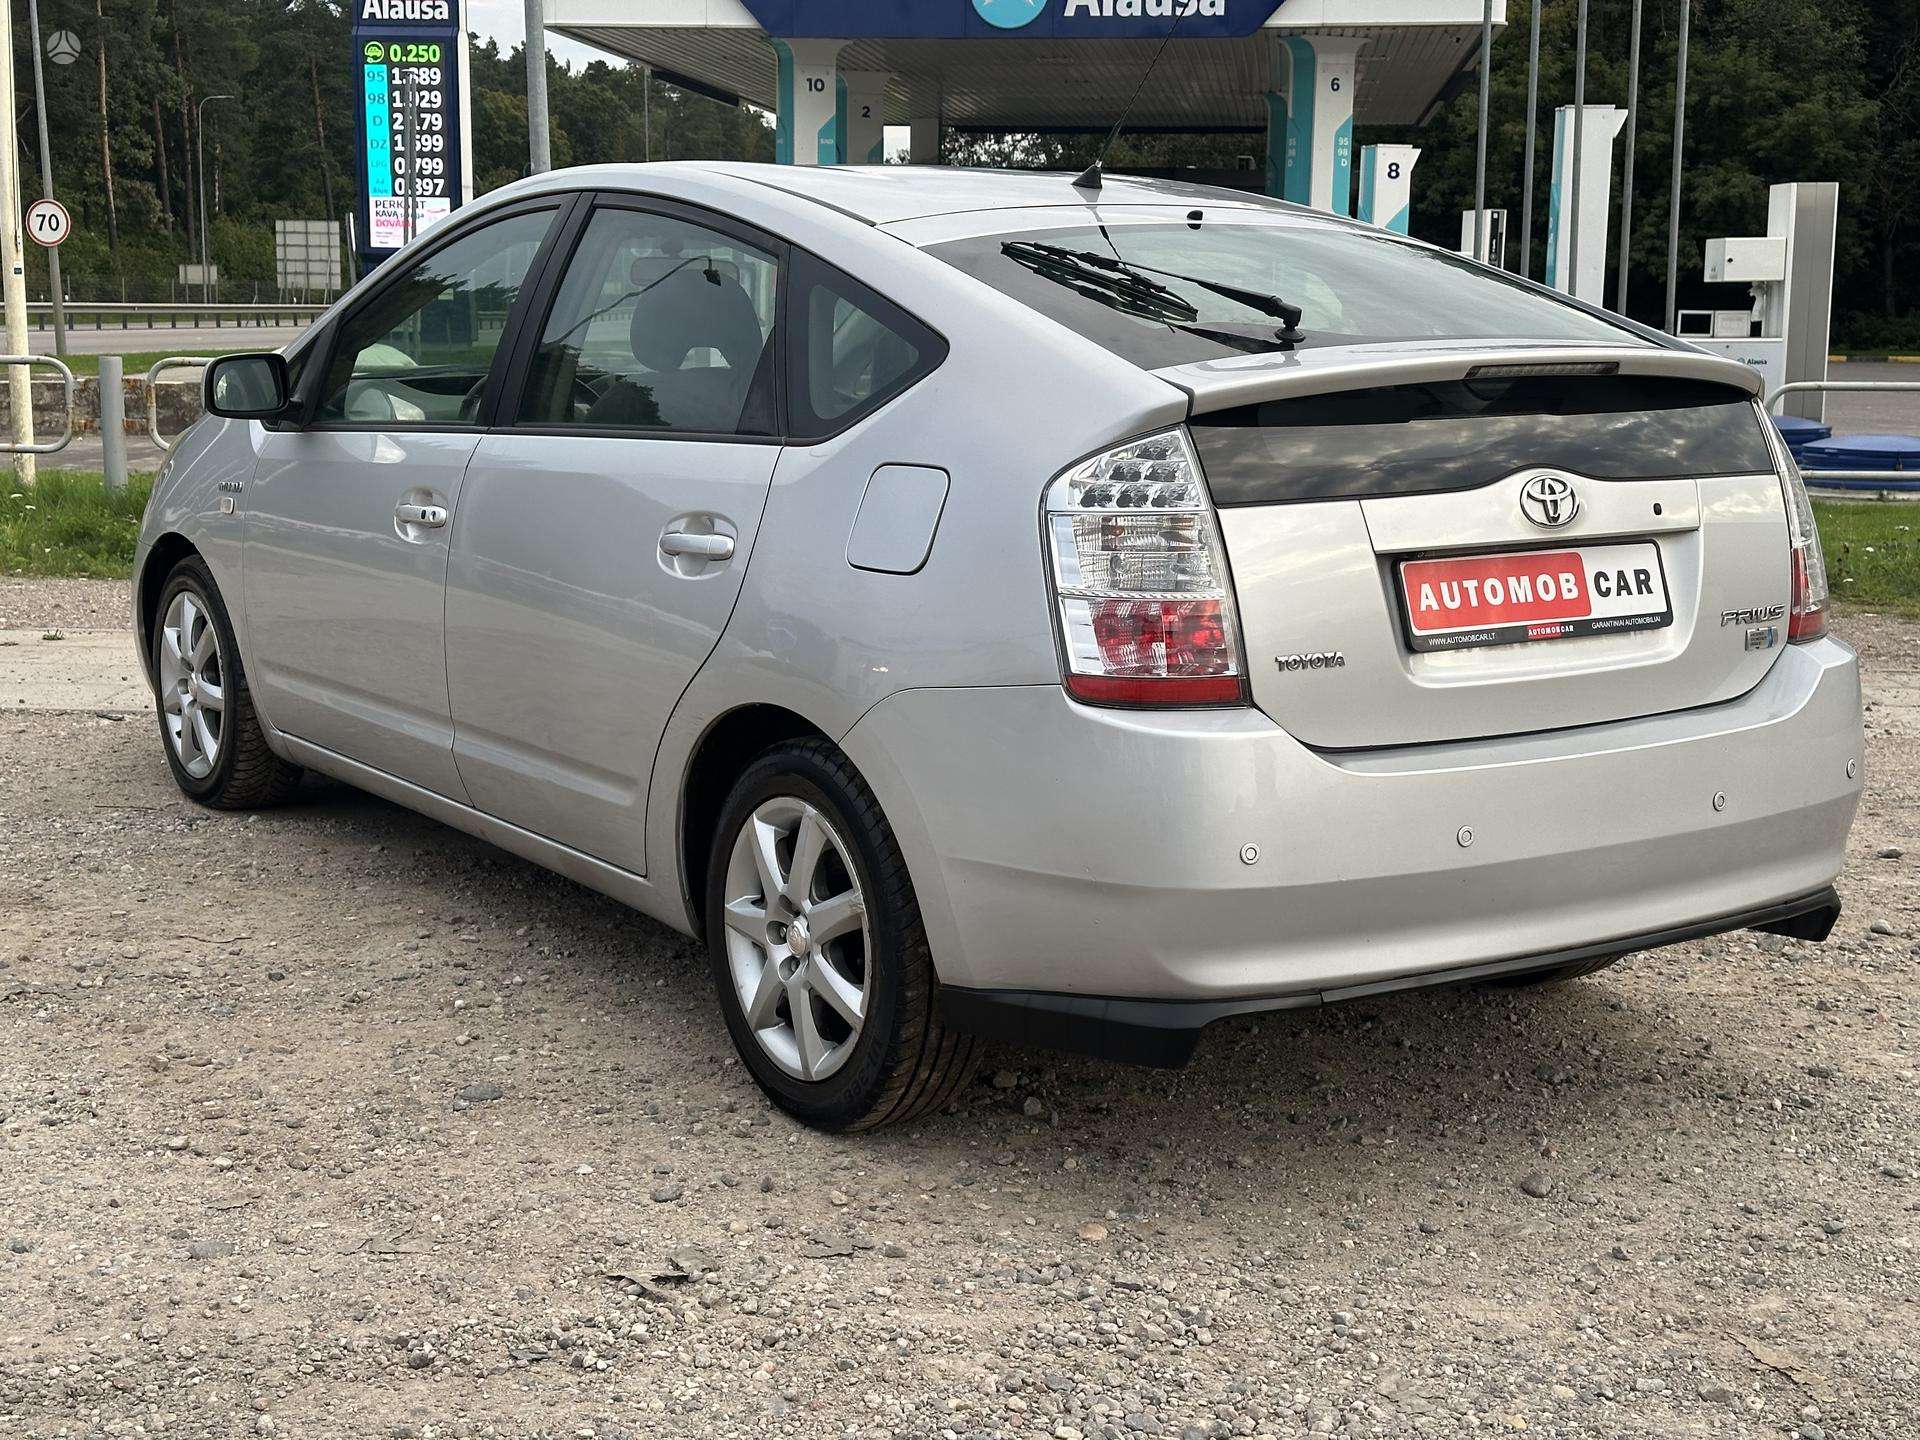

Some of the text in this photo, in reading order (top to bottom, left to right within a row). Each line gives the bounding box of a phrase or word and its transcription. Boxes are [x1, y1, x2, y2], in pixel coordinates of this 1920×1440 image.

[362, 0, 449, 20] Alausa
[389, 44, 441, 62] 0.250
[367, 71, 385, 82] 95
[1330, 77, 1340, 91] 6
[806, 78, 825, 92] 10
[368, 93, 386, 104] 98
[862, 106, 871, 118] 2
[372, 115, 383, 126] D
[1387, 162, 1400, 179] 8
[36, 213, 60, 231] 70
[1419, 568, 1654, 612] AUTOMOB CAR
[1720, 604, 1785, 627] PRIUS
[1428, 632, 1496, 646] WWW.AUTOMOBCAR.LT
[1275, 651, 1346, 672] TOYOTA
